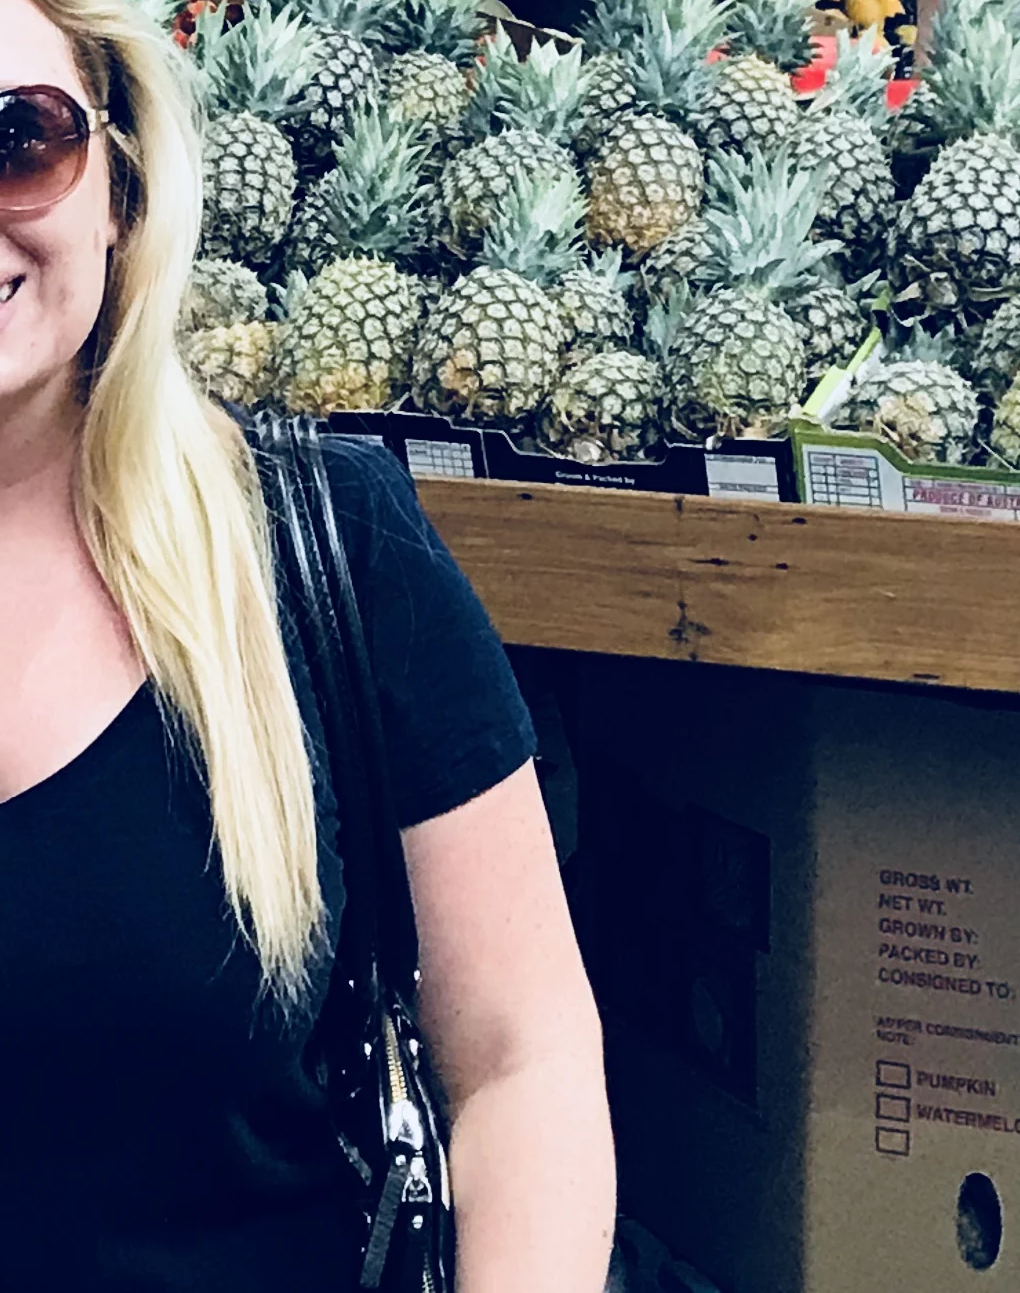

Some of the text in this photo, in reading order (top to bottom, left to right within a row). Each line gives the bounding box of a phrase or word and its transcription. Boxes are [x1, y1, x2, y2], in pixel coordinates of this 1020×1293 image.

[879, 869, 941, 892] GROSS
[878, 893, 913, 912] NET
[878, 917, 945, 941] GROWN
[878, 943, 949, 965] PACKED
[878, 967, 981, 995] CONSIGNED
[916, 1070, 997, 1097] PUMPKIN
